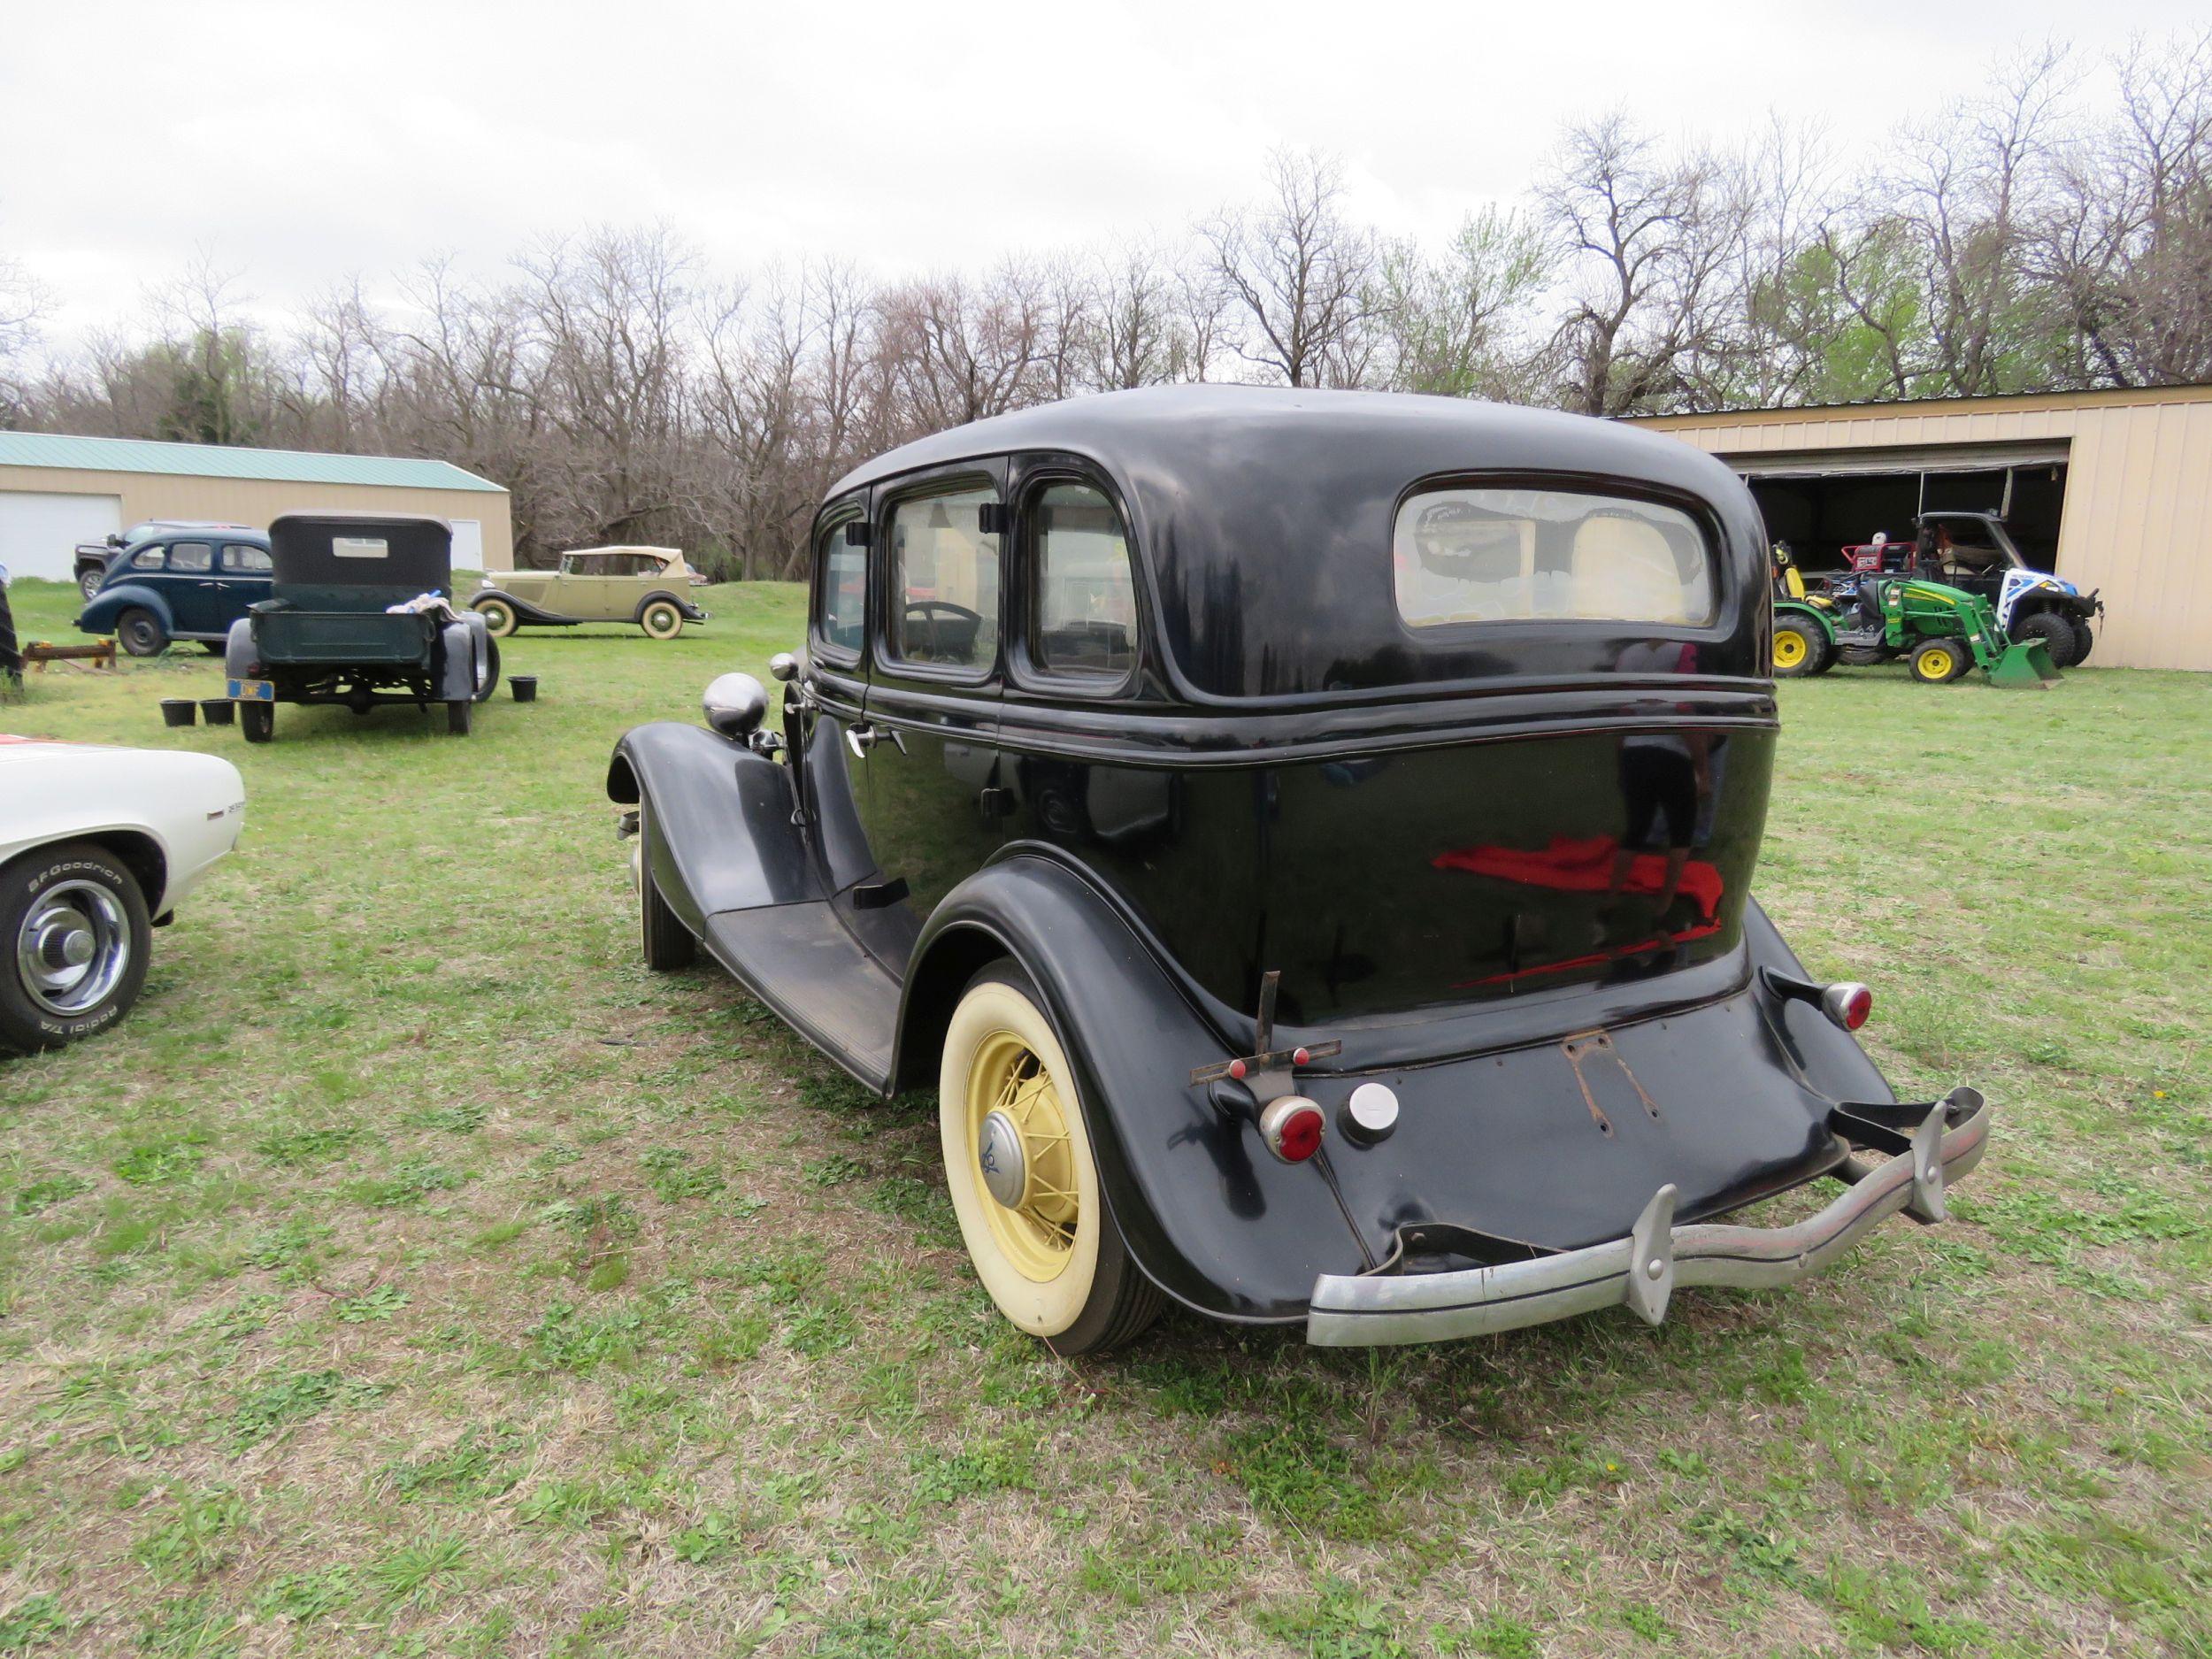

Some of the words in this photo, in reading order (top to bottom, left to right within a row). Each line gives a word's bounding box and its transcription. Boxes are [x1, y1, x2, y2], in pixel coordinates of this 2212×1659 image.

[28, 861, 122, 893] BFGoodrich
[41, 1020, 64, 1034] T/A
[69, 1005, 118, 1033] Radial
